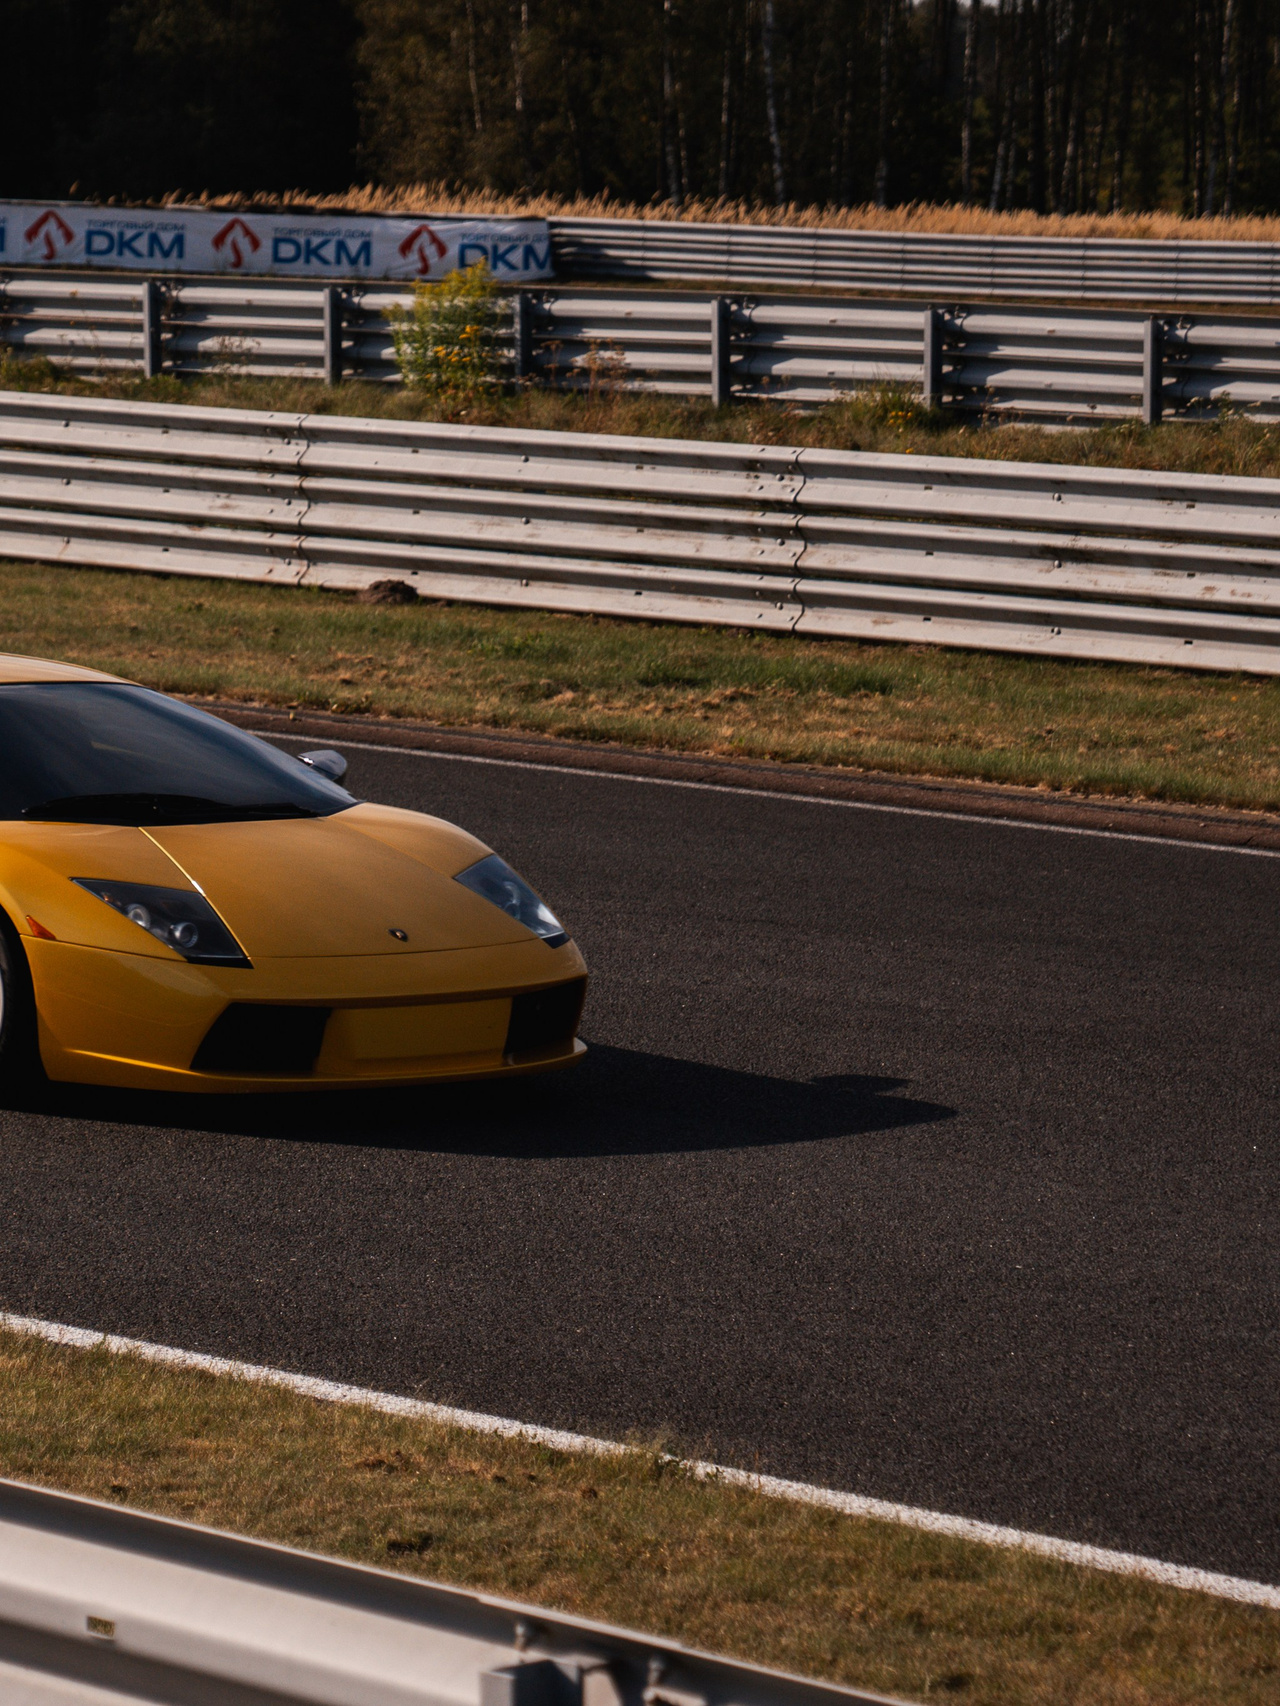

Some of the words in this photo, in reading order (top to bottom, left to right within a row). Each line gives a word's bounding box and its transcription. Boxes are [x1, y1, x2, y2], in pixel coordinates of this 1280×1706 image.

[85, 229, 185, 259] DKM
[344, 229, 372, 238] ДОМ
[272, 236, 372, 267] DKM
